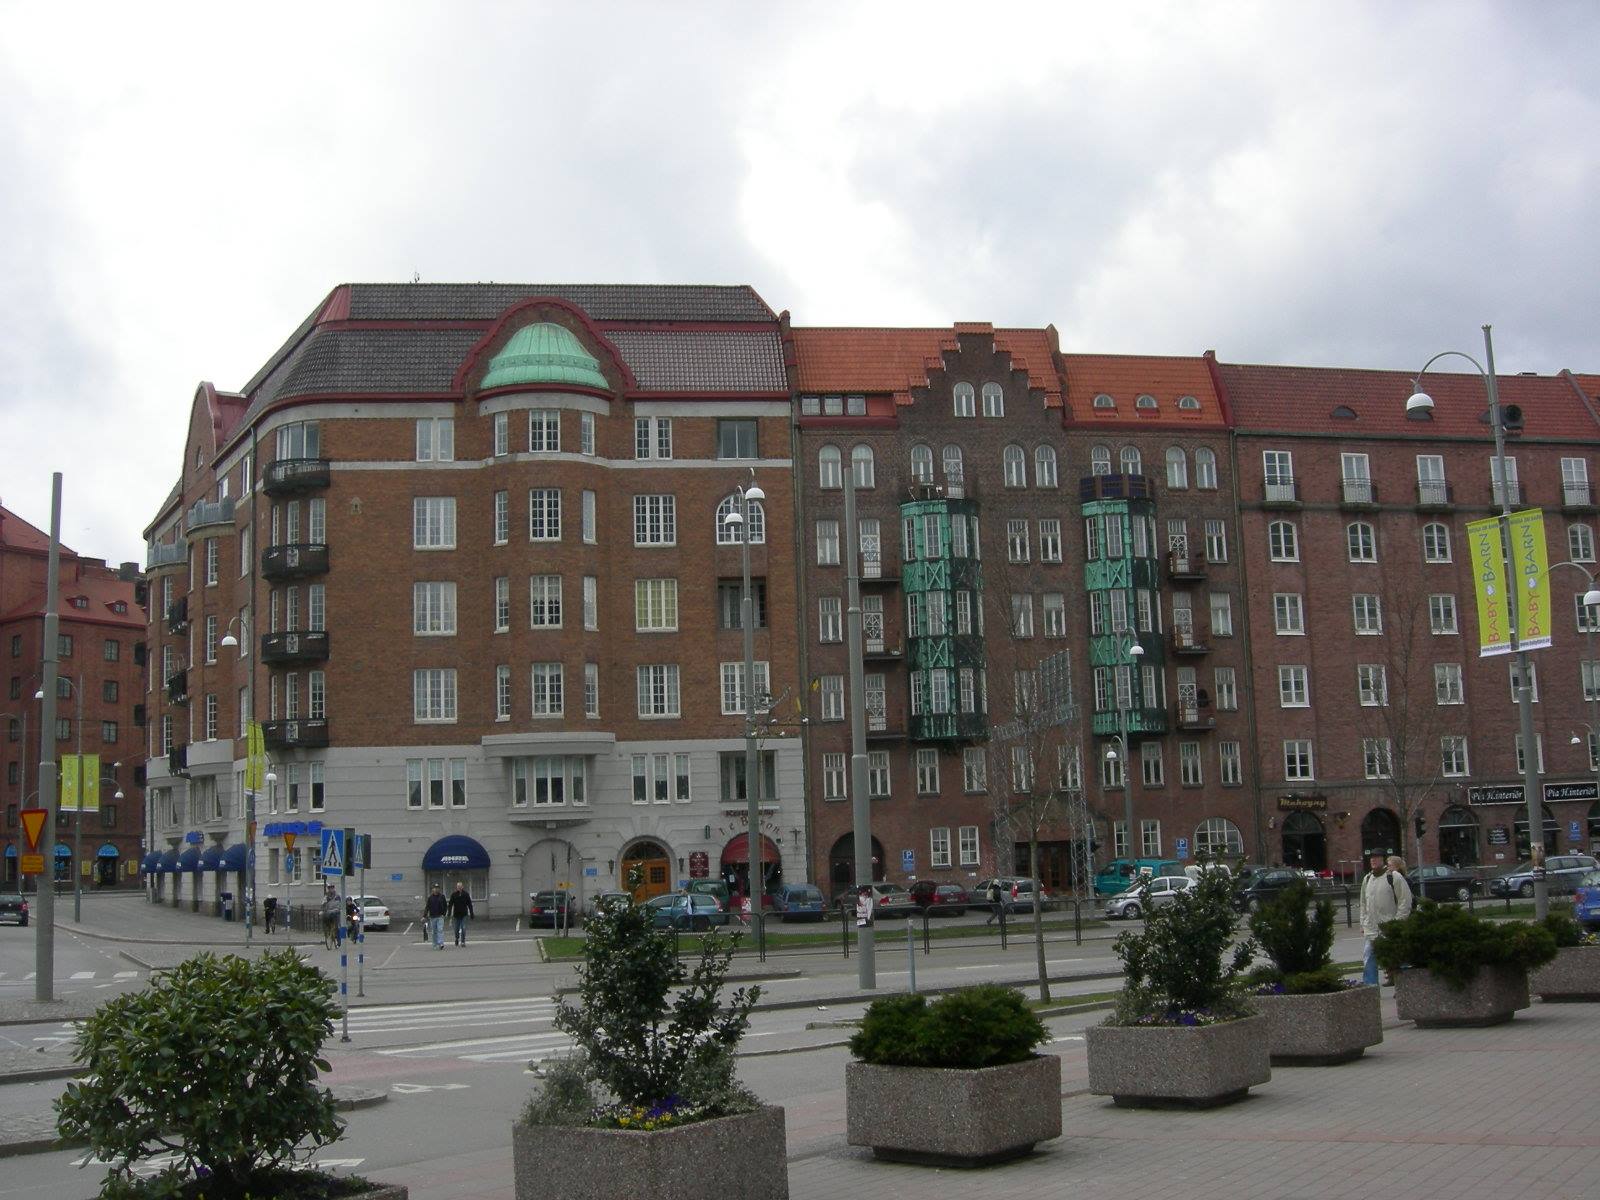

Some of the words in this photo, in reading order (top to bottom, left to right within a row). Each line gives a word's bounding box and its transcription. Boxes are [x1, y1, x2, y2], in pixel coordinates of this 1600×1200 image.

[1479, 533, 1496, 582] BARN
[1521, 525, 1540, 576] BARN
[1487, 597, 1500, 643] BABY
[1527, 591, 1541, 637] BABY
